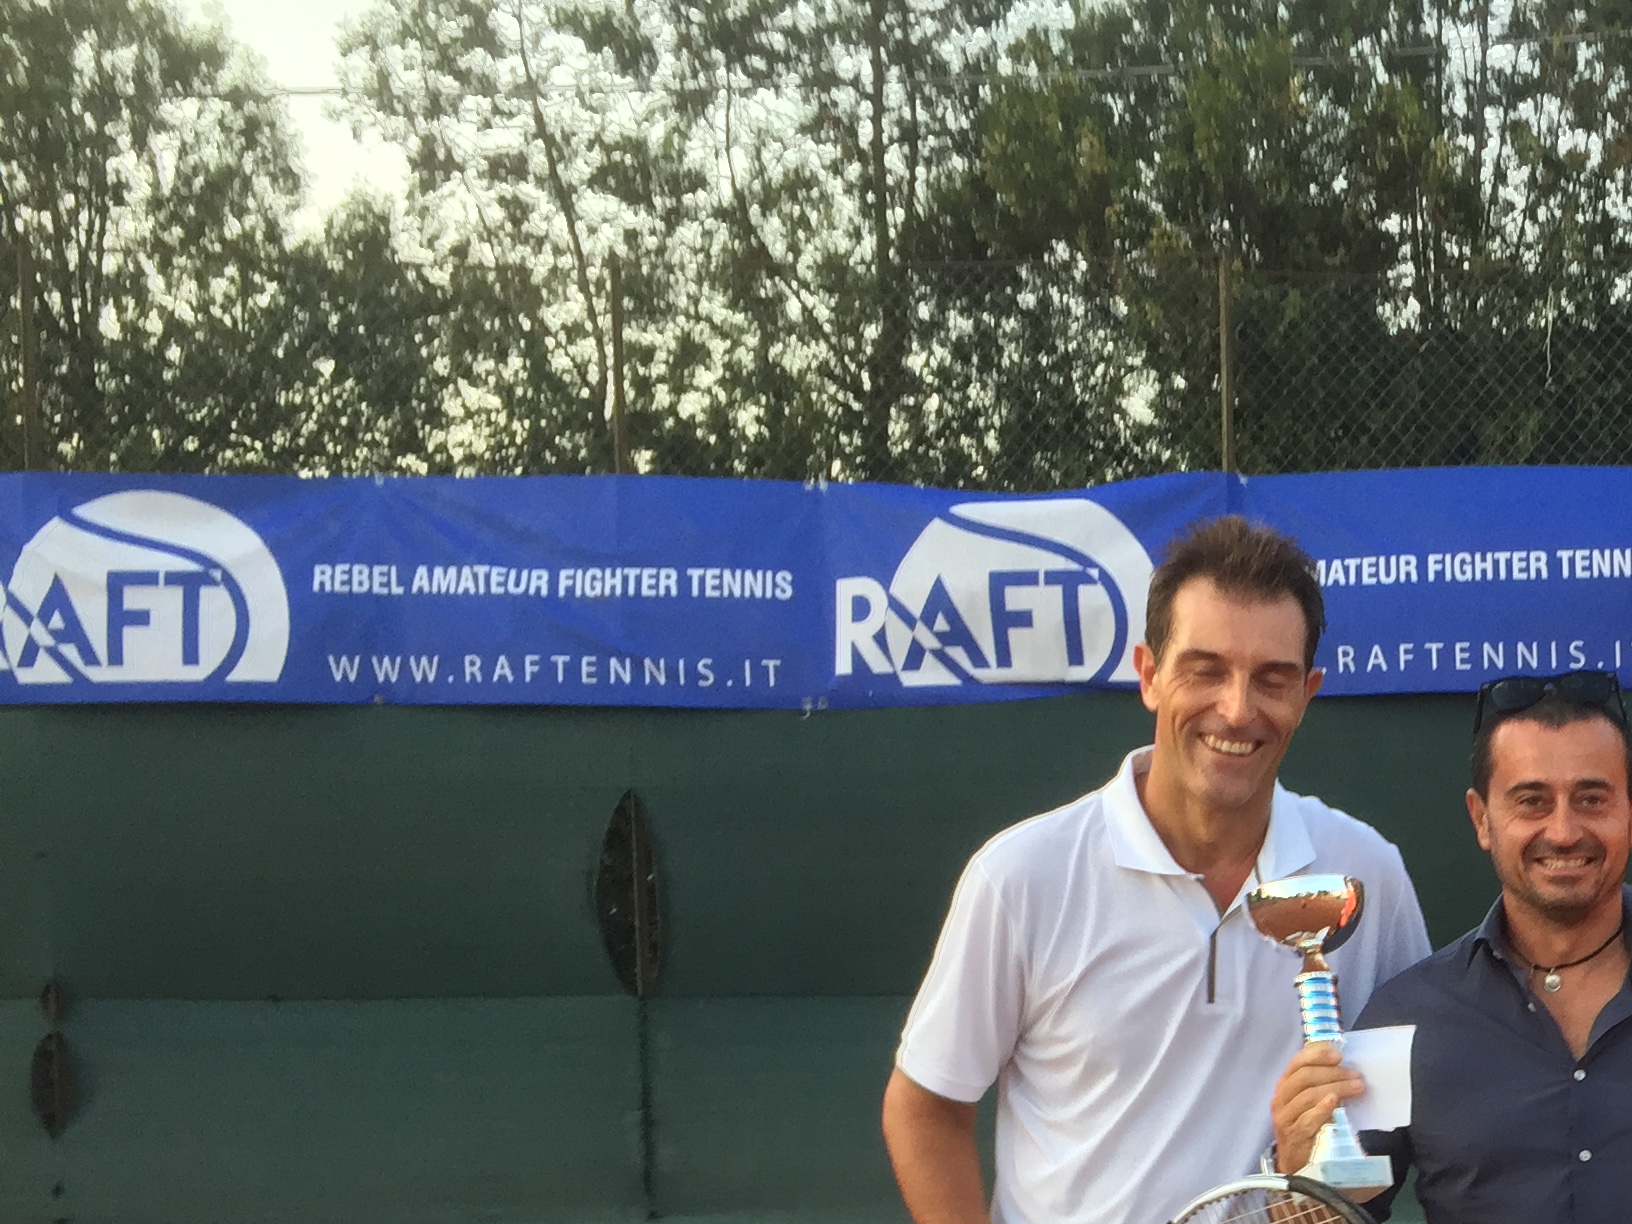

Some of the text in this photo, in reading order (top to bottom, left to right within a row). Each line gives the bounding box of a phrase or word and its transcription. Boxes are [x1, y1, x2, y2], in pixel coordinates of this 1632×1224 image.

[312, 563, 793, 600] REBEL AMATEUR FIGHTER TENNIS
[1315, 554, 1418, 587] ATEUR
[1427, 550, 1549, 582] FIGHTER
[834, 567, 1105, 677] RAFT
[328, 654, 781, 688] WWW.RAFTENNIS.IT
